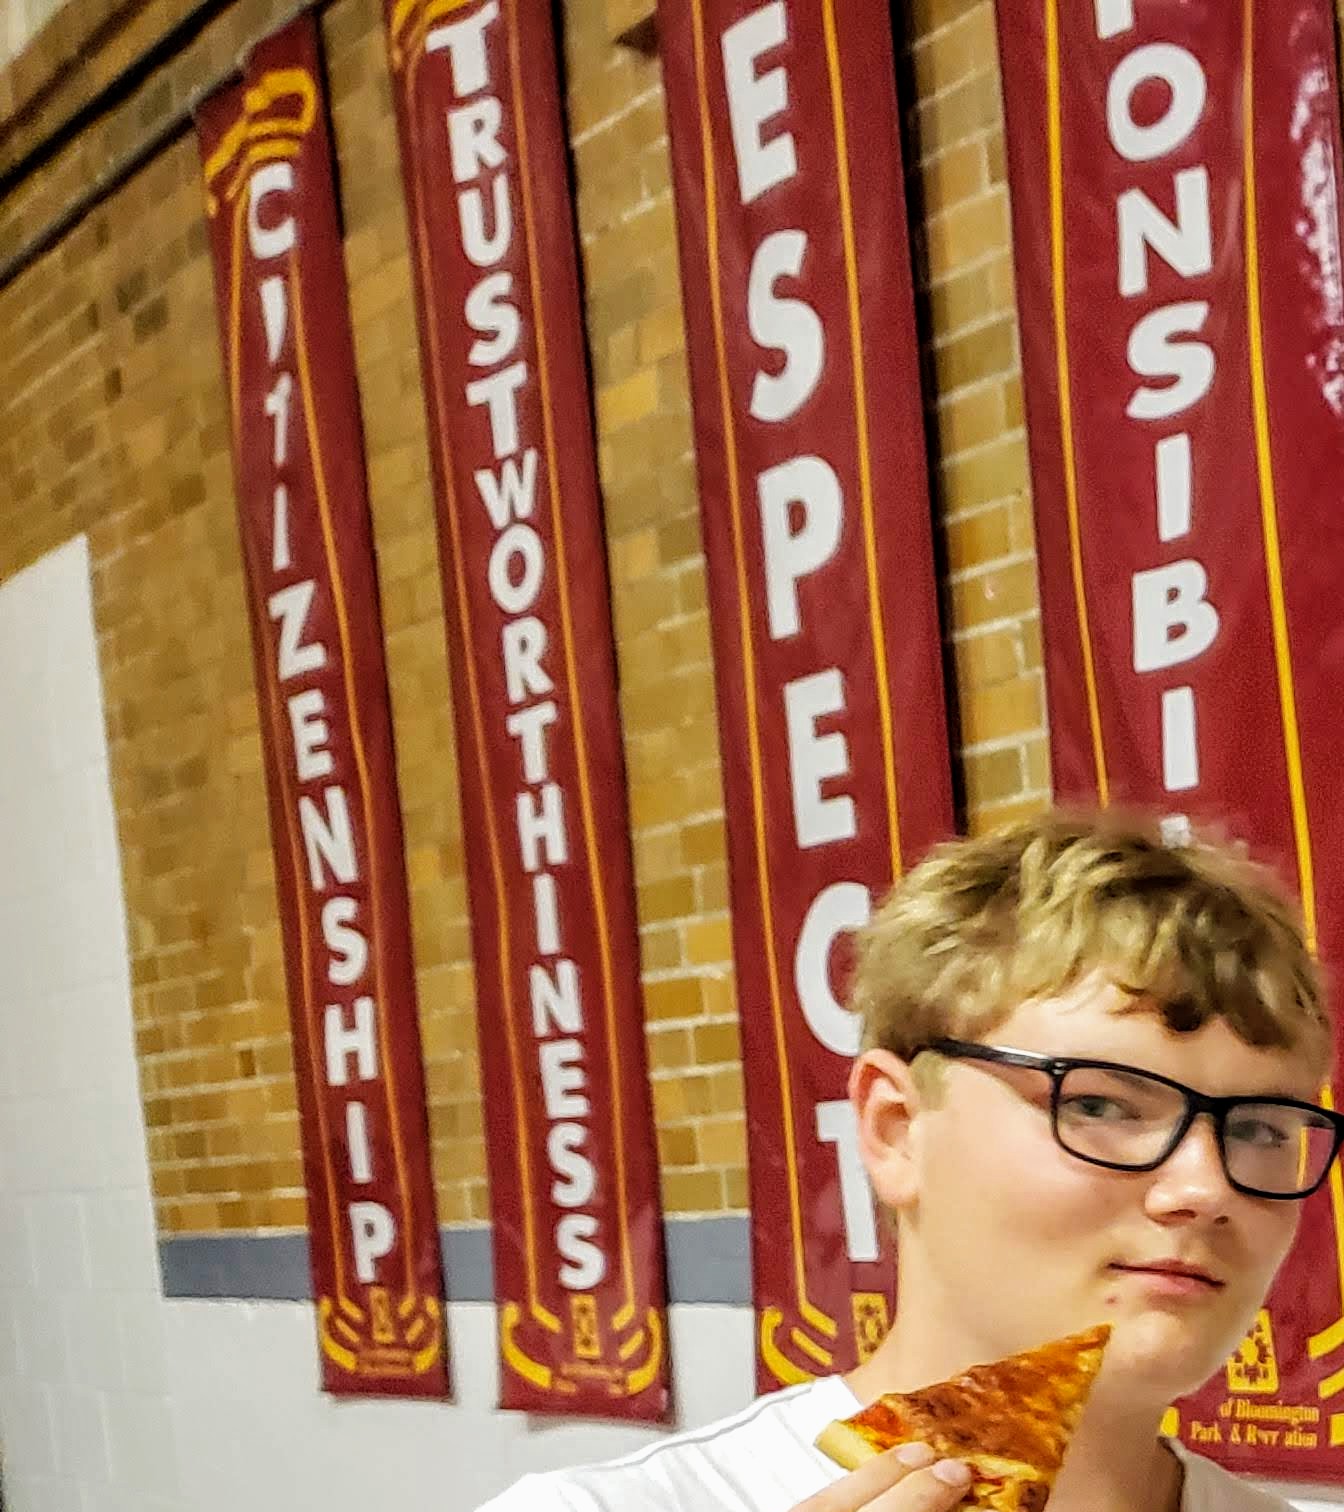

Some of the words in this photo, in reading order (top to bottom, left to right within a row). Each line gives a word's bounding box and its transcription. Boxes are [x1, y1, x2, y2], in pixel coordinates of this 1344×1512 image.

[247, 162, 395, 1284] CITIZENSHIP
[426, 1, 606, 1290] TRUSTWORTHINESS
[1095, 0, 1222, 849] ONSIBI
[1191, 1420, 1222, 1443] Park
